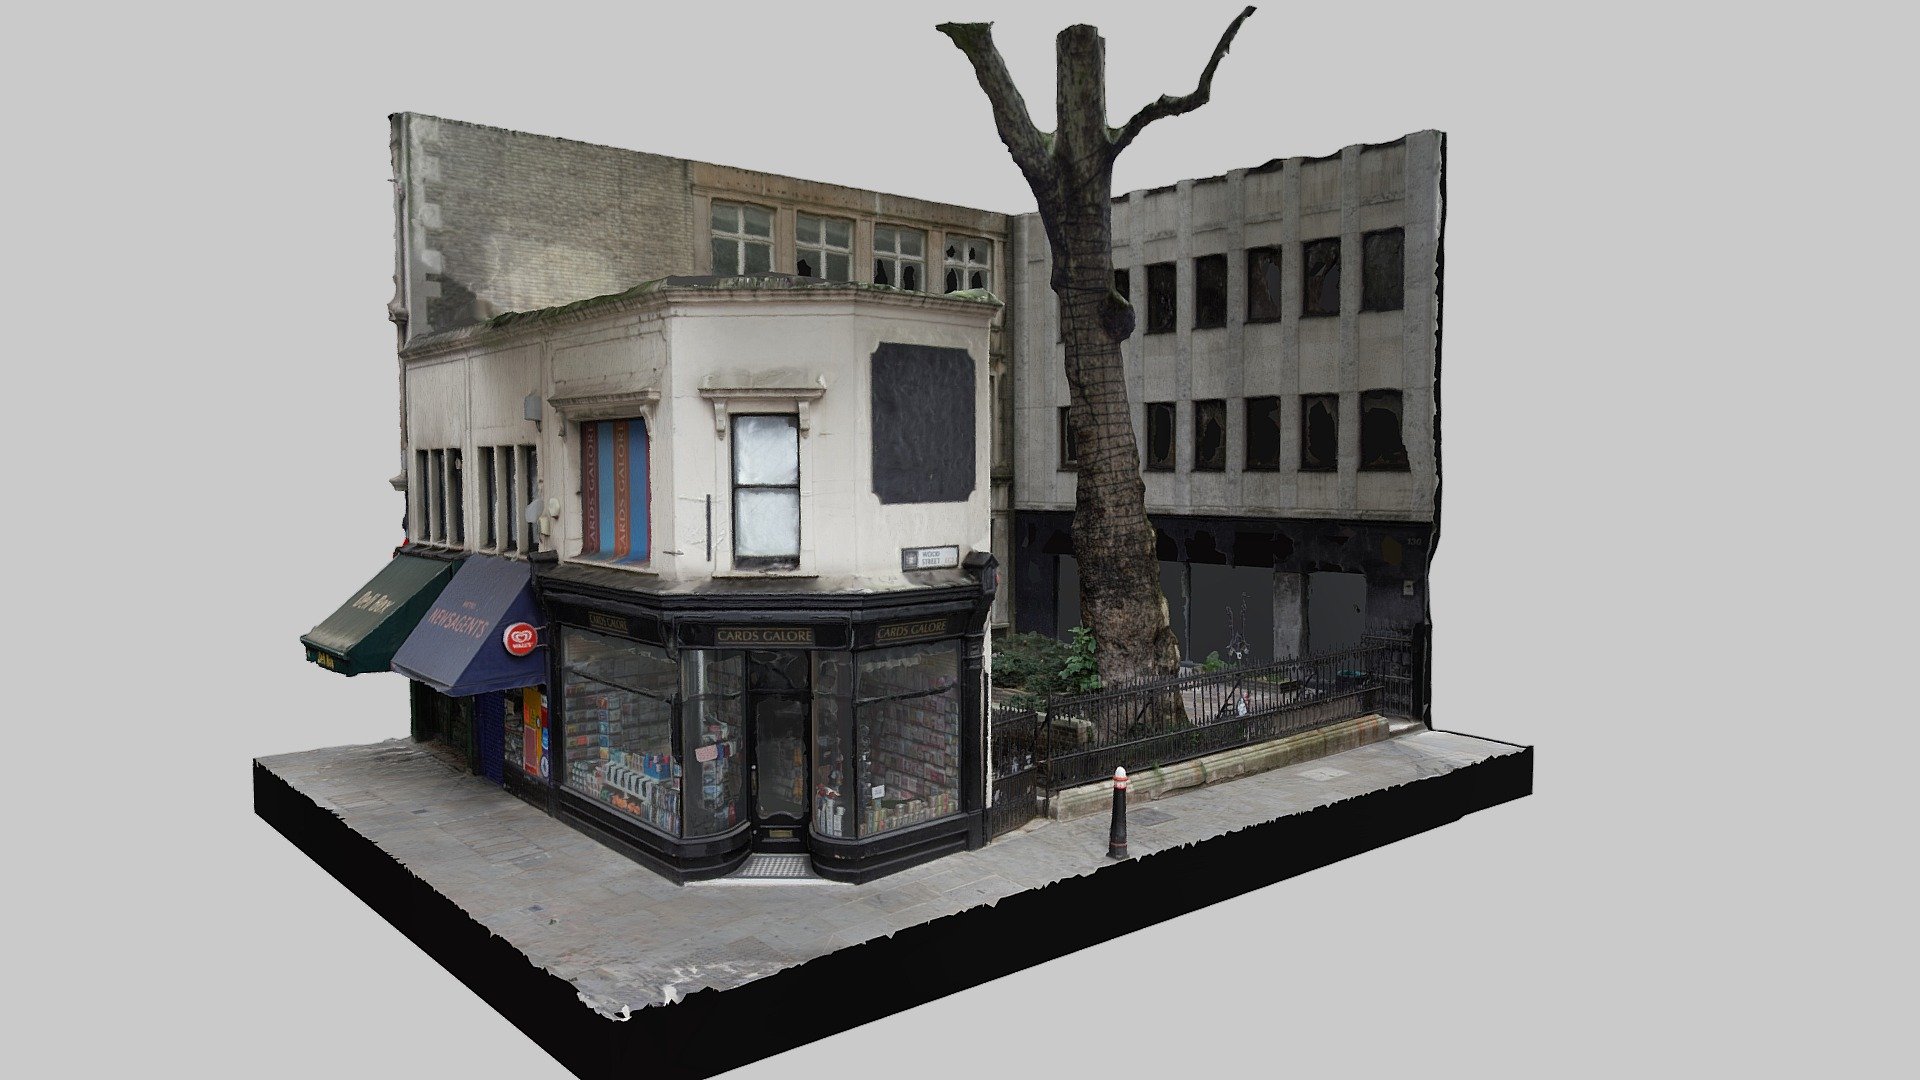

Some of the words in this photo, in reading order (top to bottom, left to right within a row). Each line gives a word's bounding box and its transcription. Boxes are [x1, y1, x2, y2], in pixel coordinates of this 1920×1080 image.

[368, 594, 396, 614] Box
[428, 607, 489, 639] NEWSAGENTS
[877, 625, 909, 638] CARDS
[911, 621, 946, 635] GALORE
[717, 630, 759, 641] CARDS
[762, 630, 812, 641] GALORE
